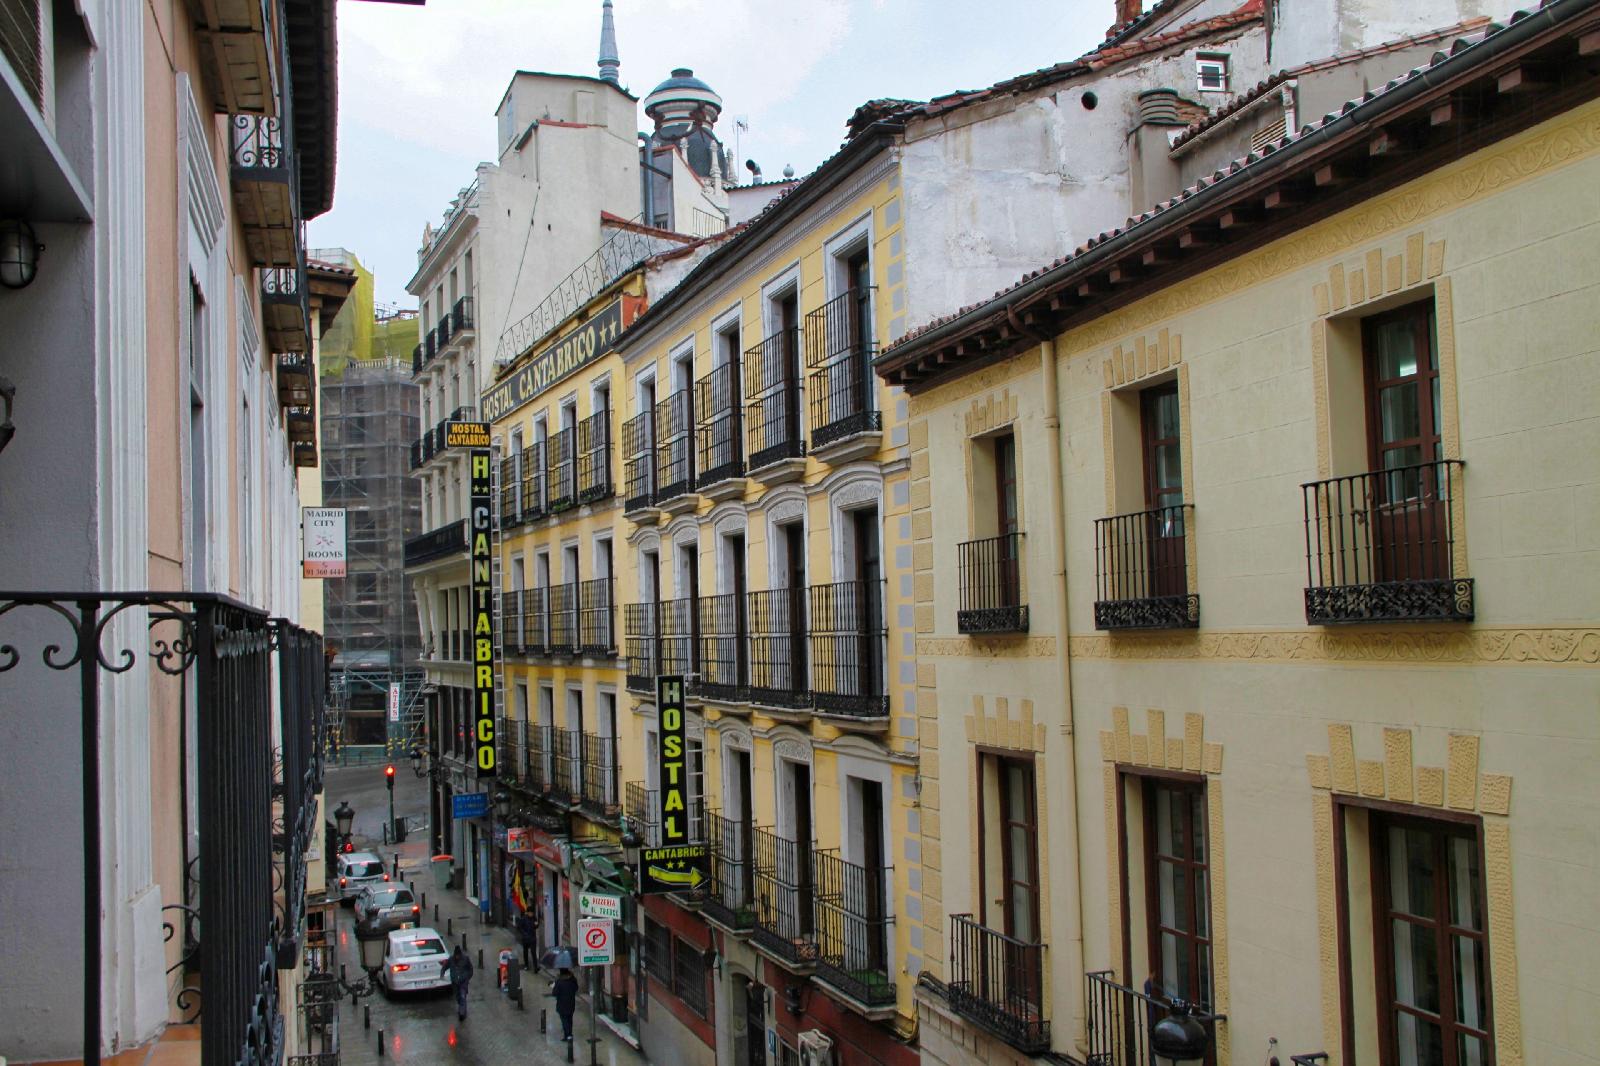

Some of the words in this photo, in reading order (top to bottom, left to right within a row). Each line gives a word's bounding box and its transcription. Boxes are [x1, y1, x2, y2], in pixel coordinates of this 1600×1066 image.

[482, 386, 514, 422] HOSTAL
[519, 325, 596, 401] CANTABRICO
[451, 423, 485, 434] HOSTAL
[448, 434, 490, 446] CANTABRICO
[472, 455, 489, 480] H
[305, 510, 344, 518] MADRID
[314, 519, 335, 527] CITY
[307, 551, 344, 559] ROOMS
[473, 506, 496, 771] CANTABRICO
[662, 681, 684, 839] HOSTAL
[645, 846, 705, 861] CANTABRICO
[592, 897, 615, 907] PIZZERIA
